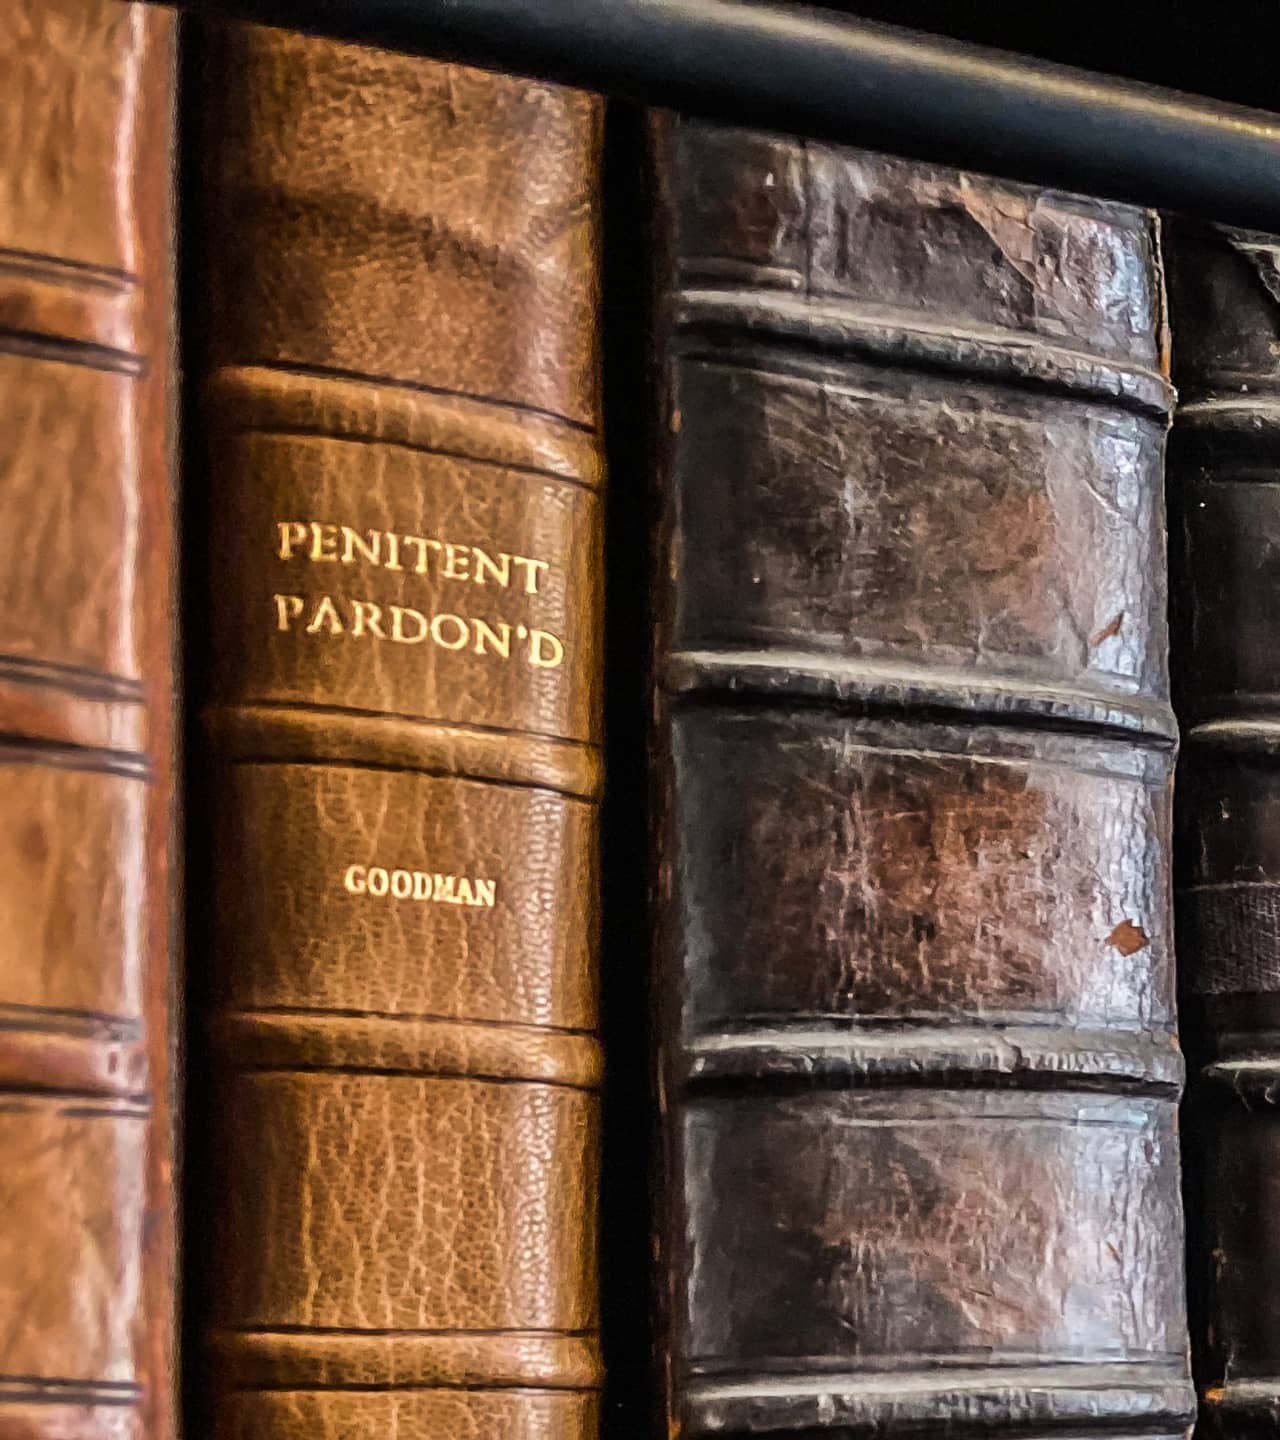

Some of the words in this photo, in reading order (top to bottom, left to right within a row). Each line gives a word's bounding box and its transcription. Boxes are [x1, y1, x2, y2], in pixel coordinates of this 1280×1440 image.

[277, 521, 549, 594] PENITENT
[274, 593, 564, 668] PARDON'D
[345, 865, 497, 907] GOODMAN
